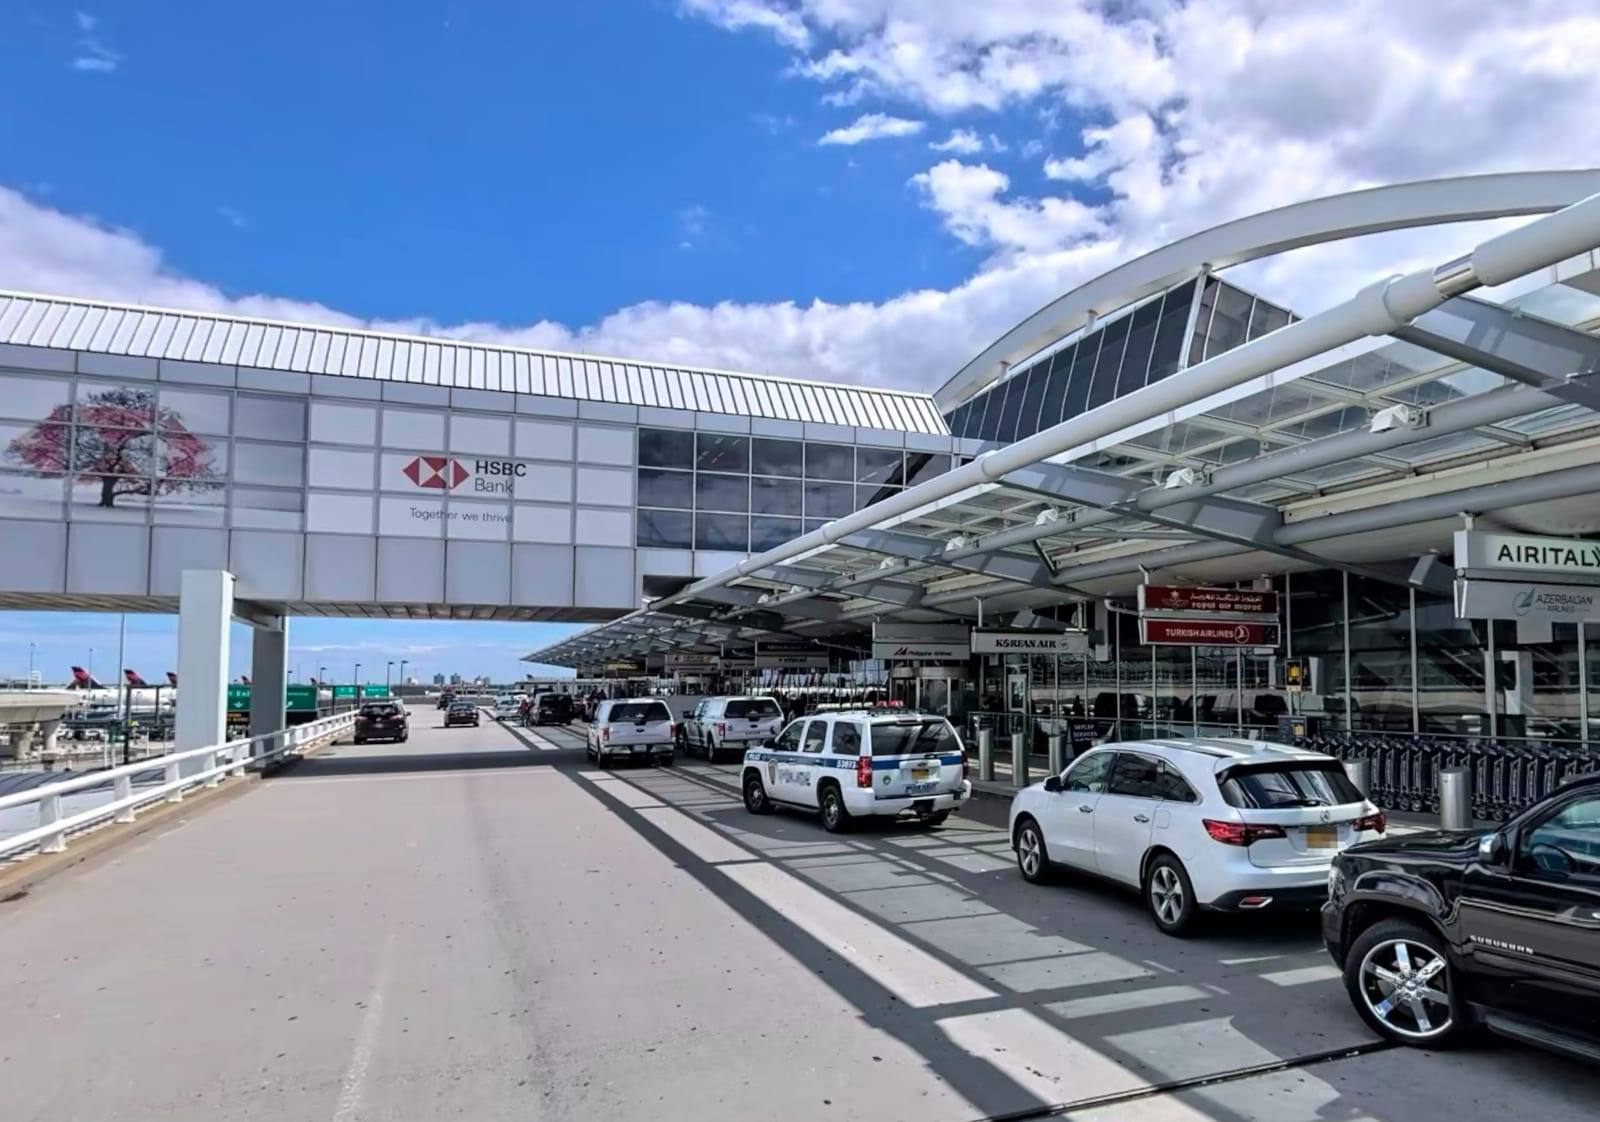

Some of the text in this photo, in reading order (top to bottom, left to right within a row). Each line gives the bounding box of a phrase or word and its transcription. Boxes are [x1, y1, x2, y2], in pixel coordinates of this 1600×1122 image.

[475, 460, 527, 477] HSBC
[474, 477, 513, 494] Bank
[410, 507, 513, 523] Together we thrive
[995, 639, 1057, 649] KOREAN AIR
[1470, 934, 1534, 954] SUBURBAN
